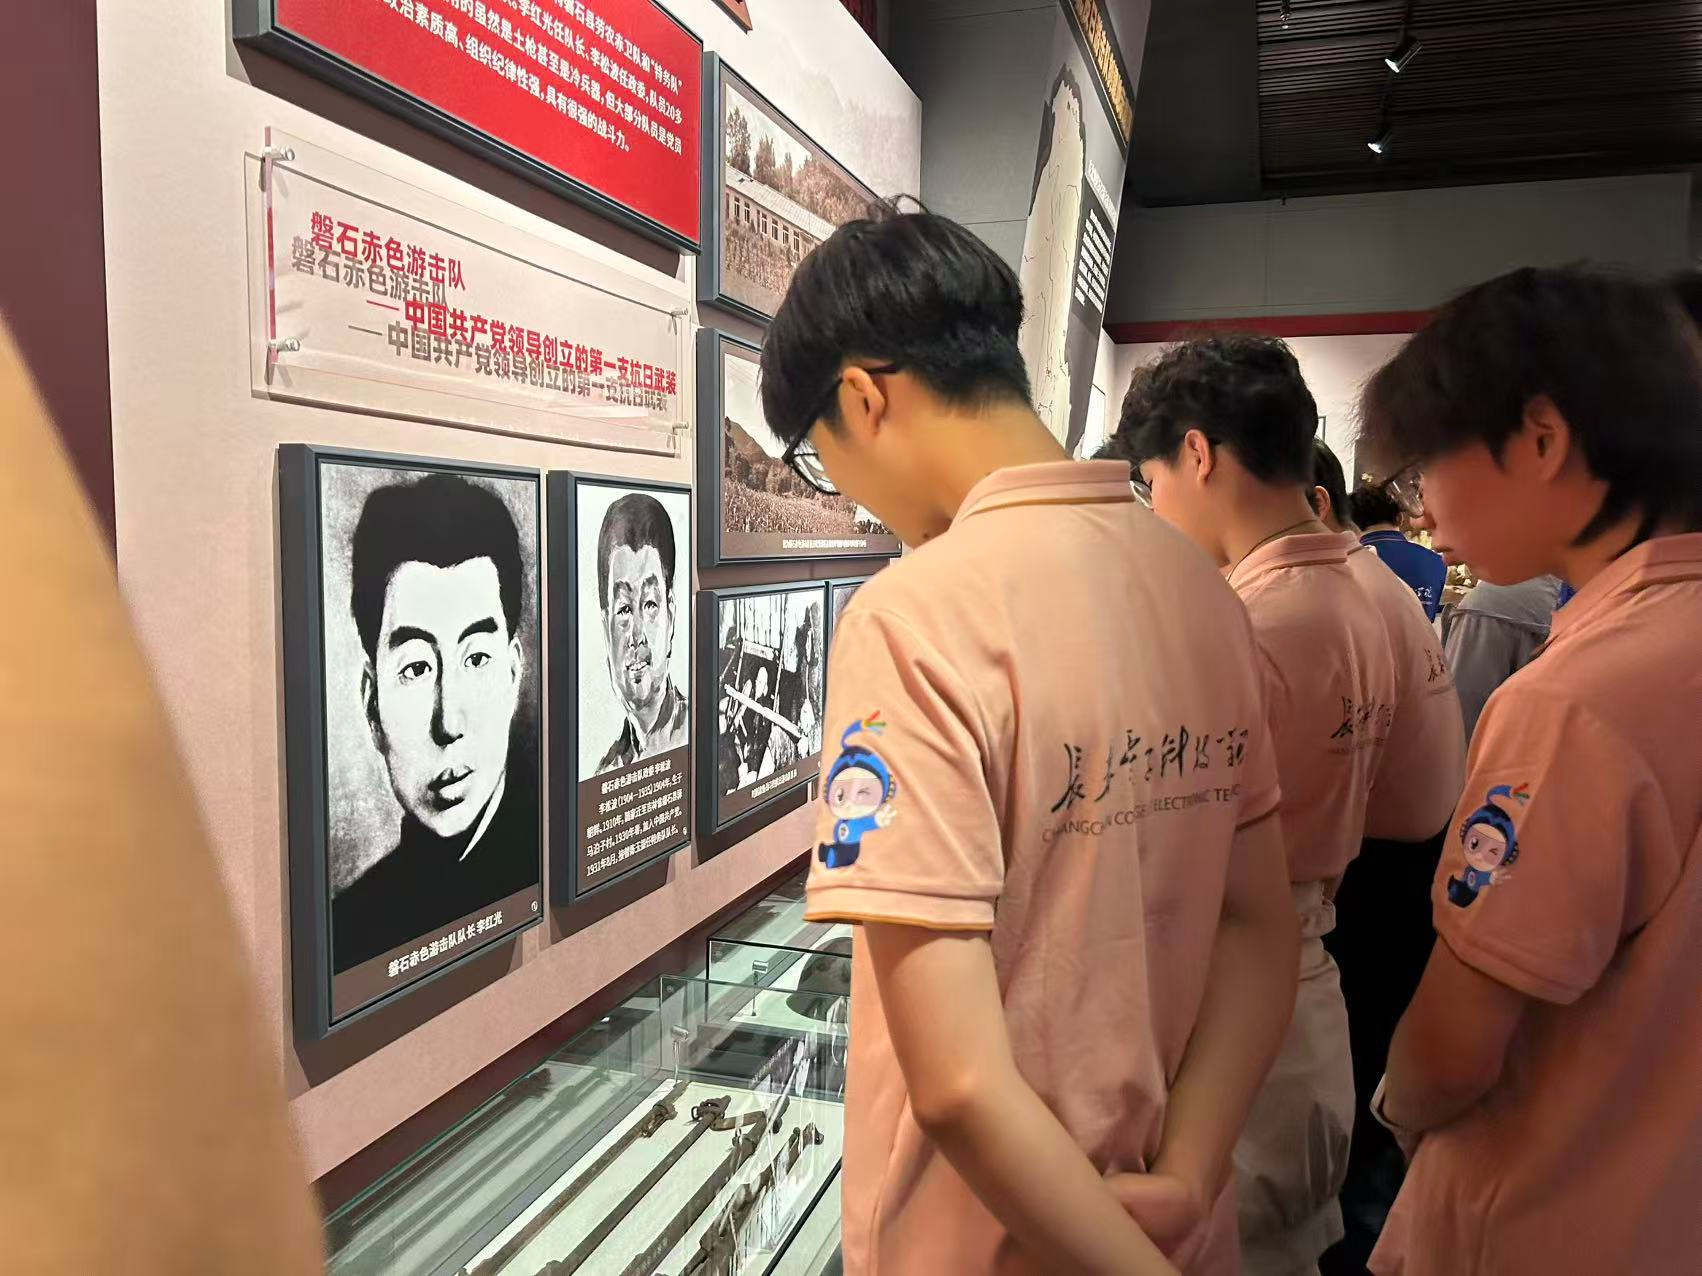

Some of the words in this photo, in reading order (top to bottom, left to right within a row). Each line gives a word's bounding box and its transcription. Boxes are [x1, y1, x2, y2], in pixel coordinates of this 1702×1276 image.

[443, 0, 682, 155] 的虽然是土枪甚至是冷兵器，但大部分队员是党员
[503, 0, 683, 124] 。李红光任队长、李松波任政委，队员20多
[554, 0, 683, 95] 磐石县劳农赤卫队和“特务队”
[310, 211, 466, 291] 磐石赤色游击队
[388, 925, 476, 978] 磐石赤色游击队队长
[476, 911, 503, 934] 李红光
